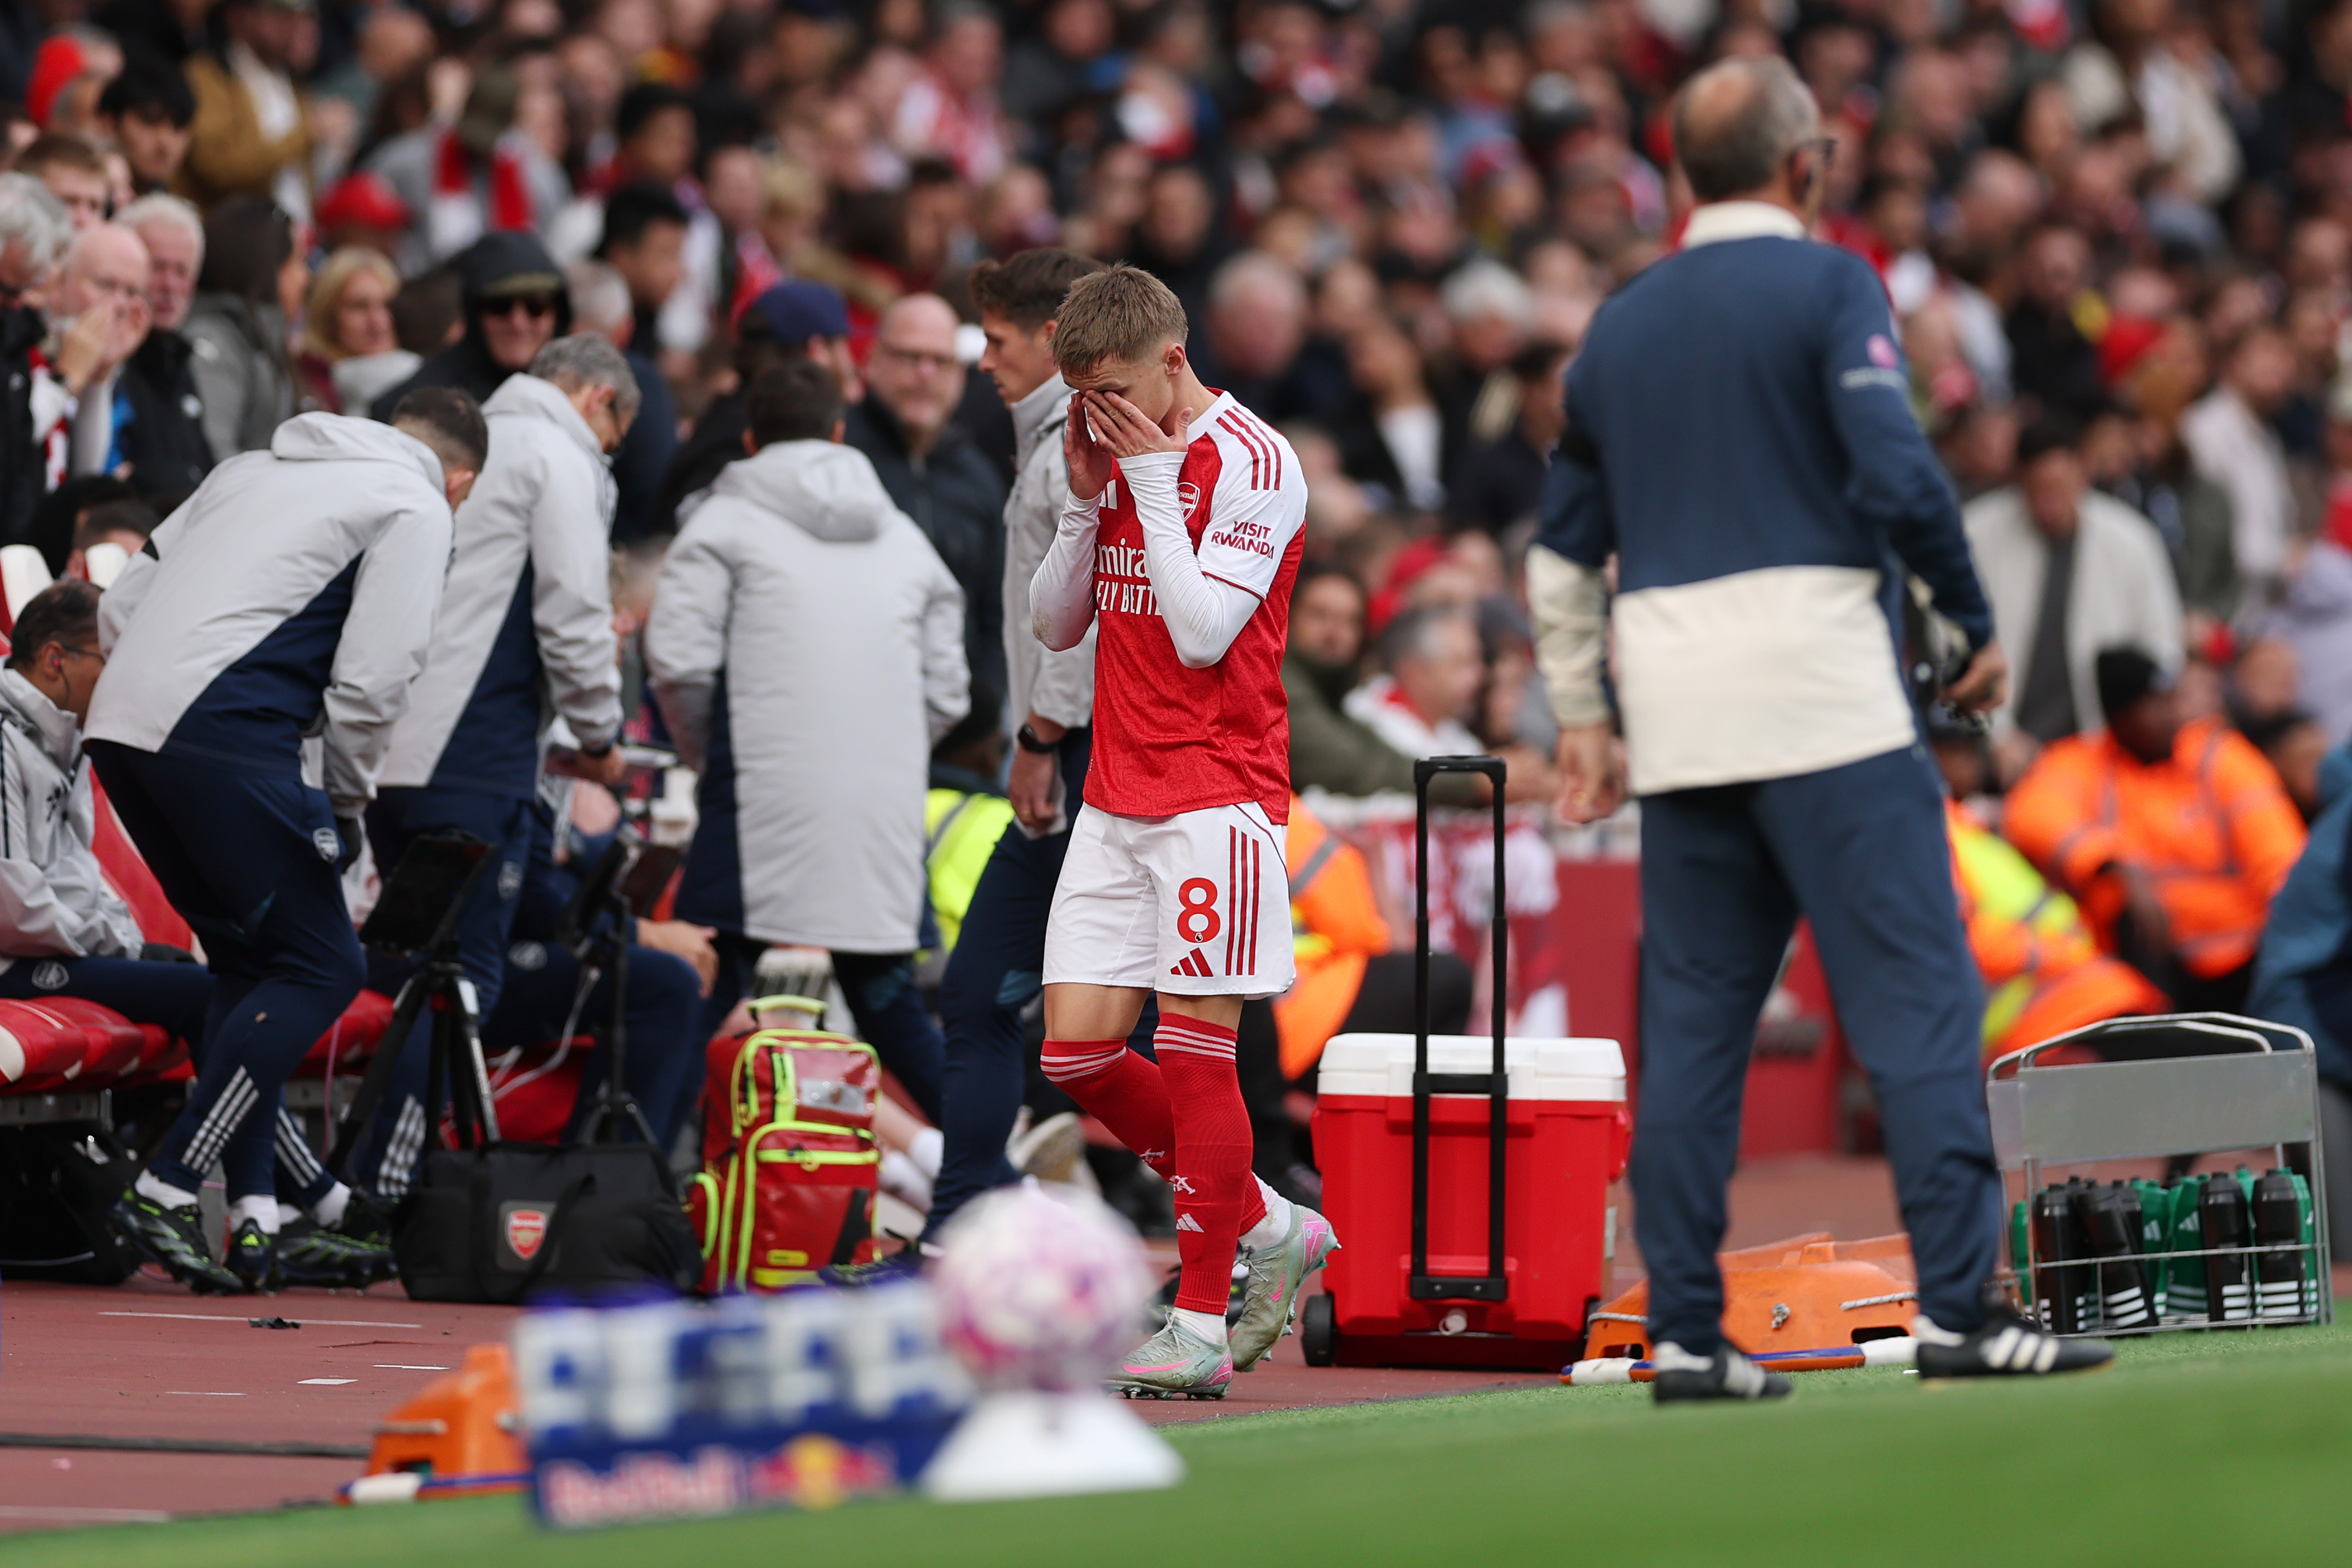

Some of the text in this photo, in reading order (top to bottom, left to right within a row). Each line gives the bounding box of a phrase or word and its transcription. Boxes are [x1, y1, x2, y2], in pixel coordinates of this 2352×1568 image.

[1233, 520, 1271, 539] VISIT
[1093, 537, 1150, 579] mira
[1210, 531, 1275, 560] RWANDA
[1096, 580, 1119, 611] FLY
[1176, 877, 1221, 944] 8
